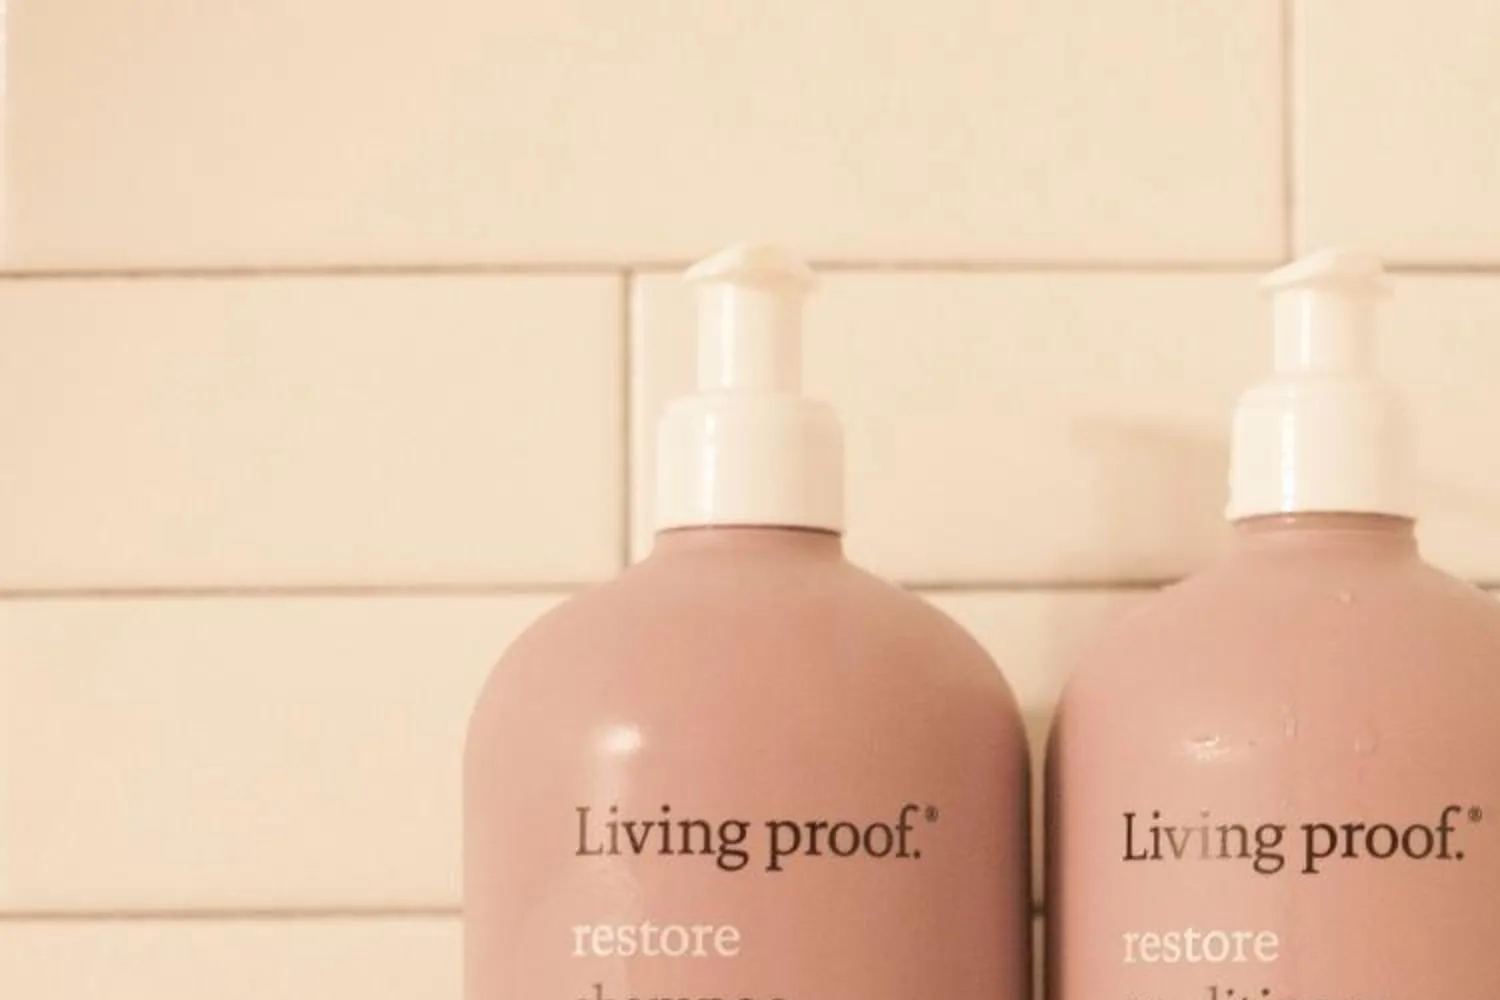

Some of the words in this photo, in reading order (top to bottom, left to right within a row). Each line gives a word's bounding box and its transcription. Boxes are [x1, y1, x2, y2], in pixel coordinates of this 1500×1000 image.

[575, 804, 750, 871] Living
[1122, 810, 1286, 874] Living
[571, 920, 740, 957] restore
[1122, 928, 1279, 963] restore
